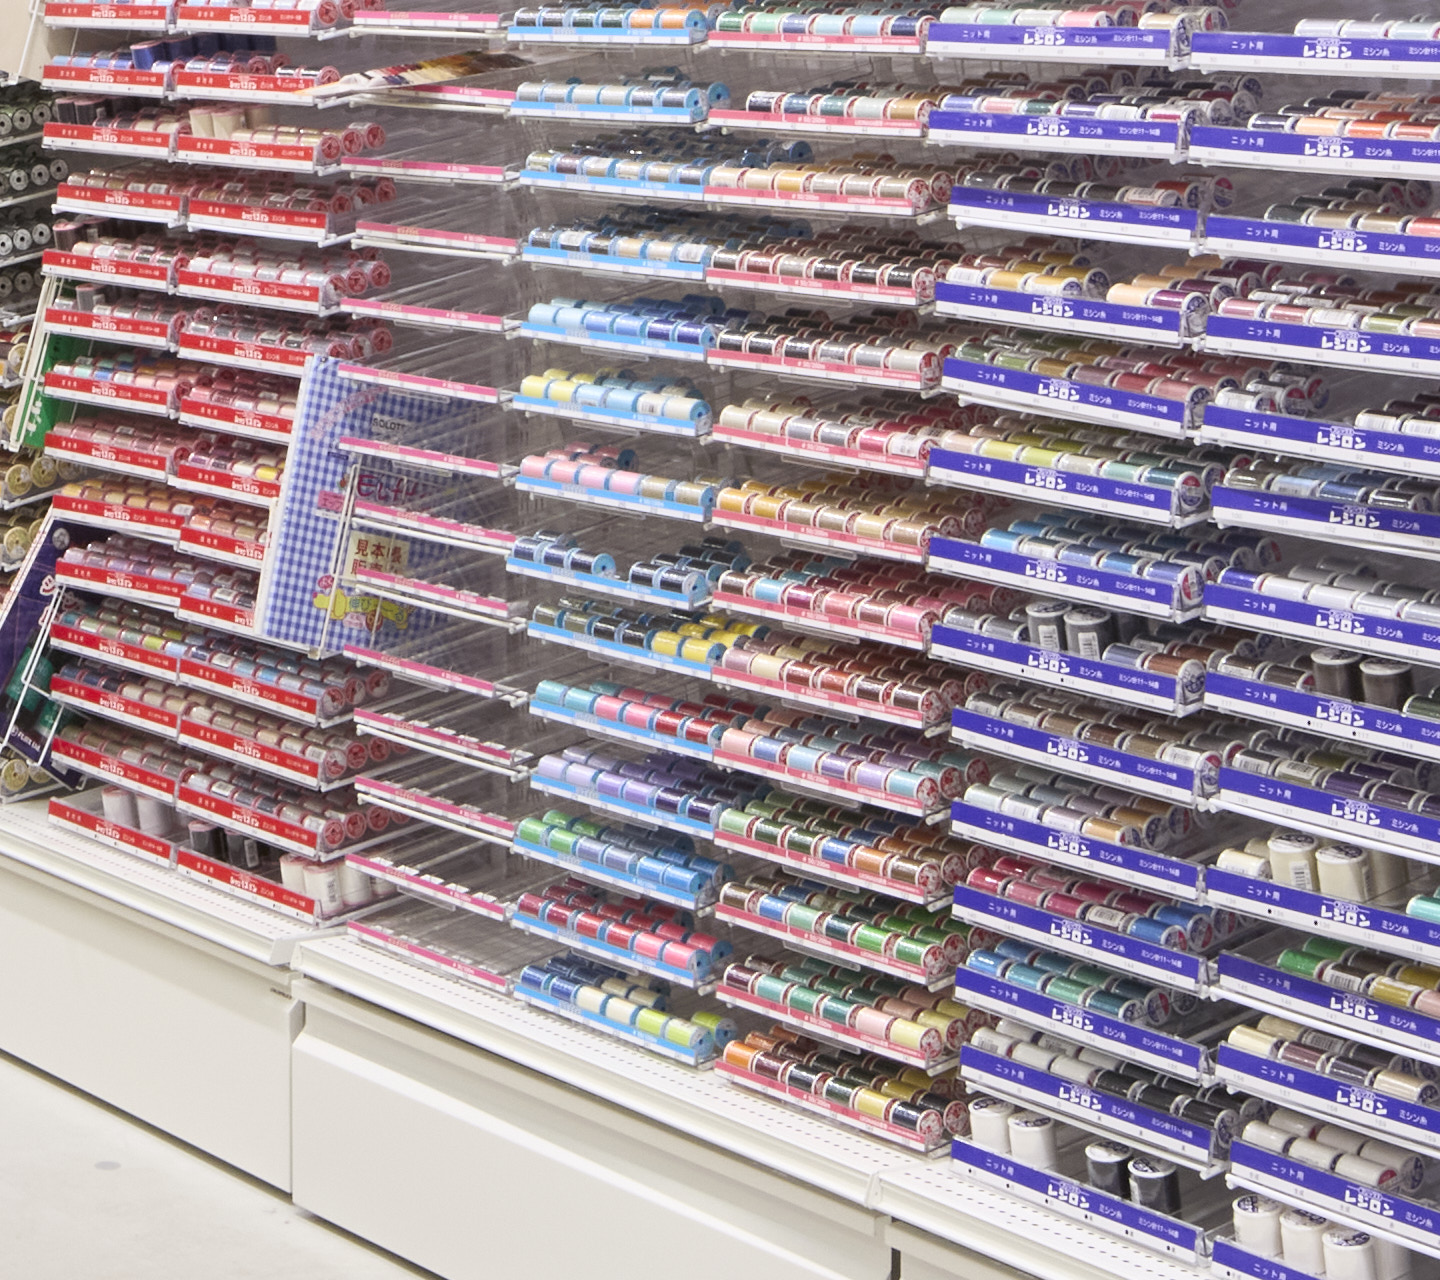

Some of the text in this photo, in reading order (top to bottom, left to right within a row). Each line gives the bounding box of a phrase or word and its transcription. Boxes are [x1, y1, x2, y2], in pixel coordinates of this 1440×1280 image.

[1246, 689, 1276, 702] ニット用
[1376, 720, 1402, 732] ミシン糸
